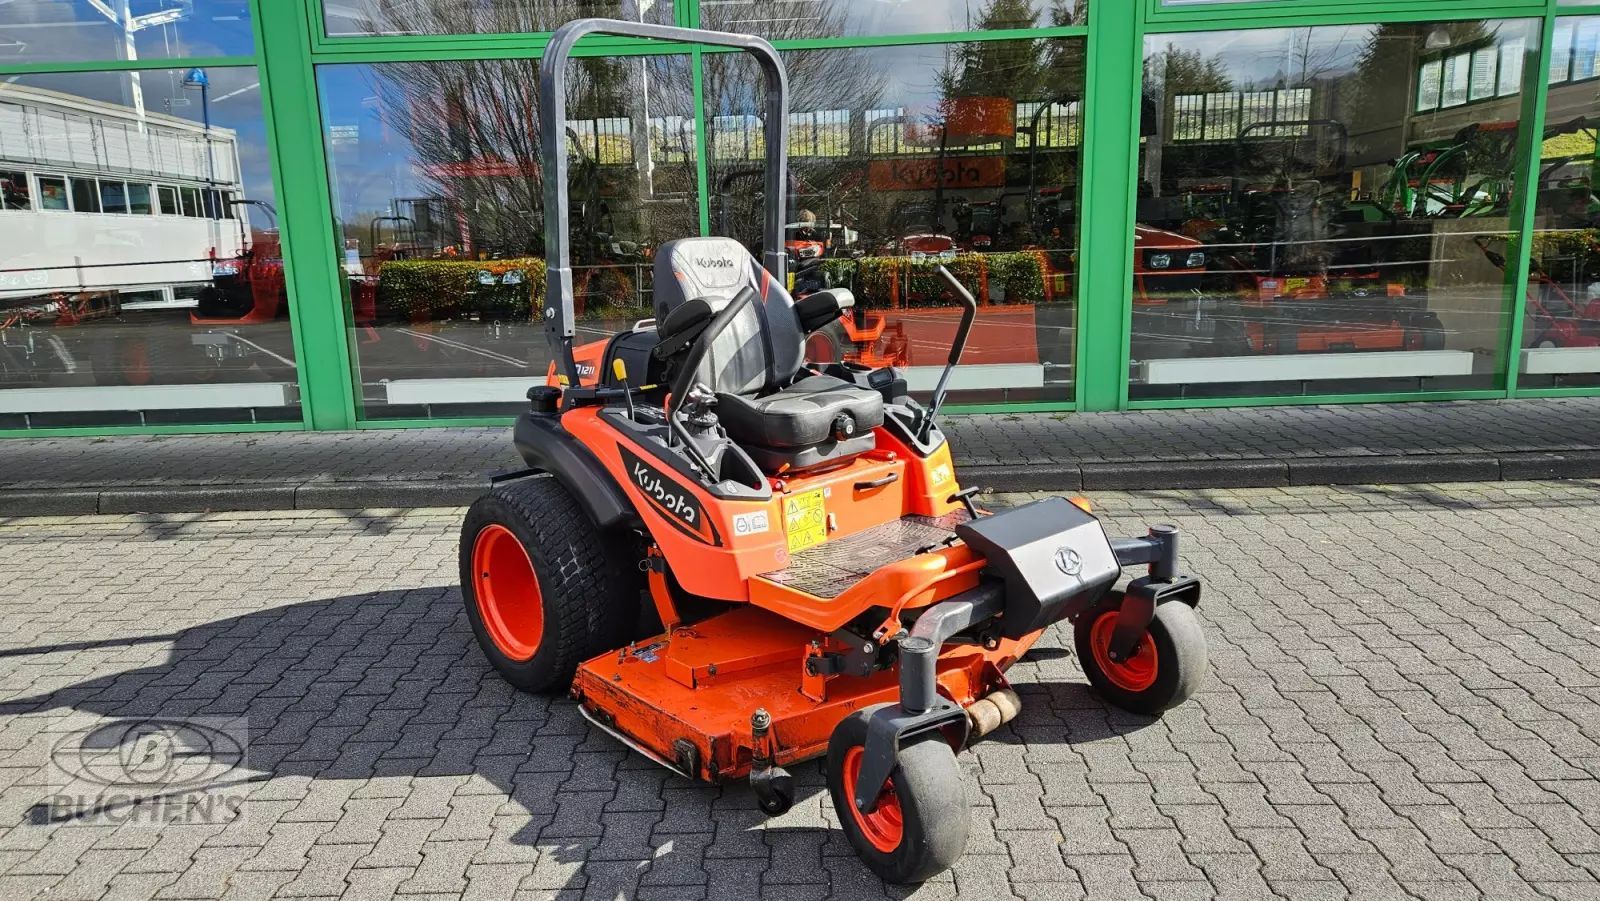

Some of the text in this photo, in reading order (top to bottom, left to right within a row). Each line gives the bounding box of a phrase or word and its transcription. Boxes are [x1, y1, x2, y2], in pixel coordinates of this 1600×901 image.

[891, 159, 981, 185] Kuota
[695, 256, 734, 269] Kubota
[633, 461, 696, 524] Kubota
